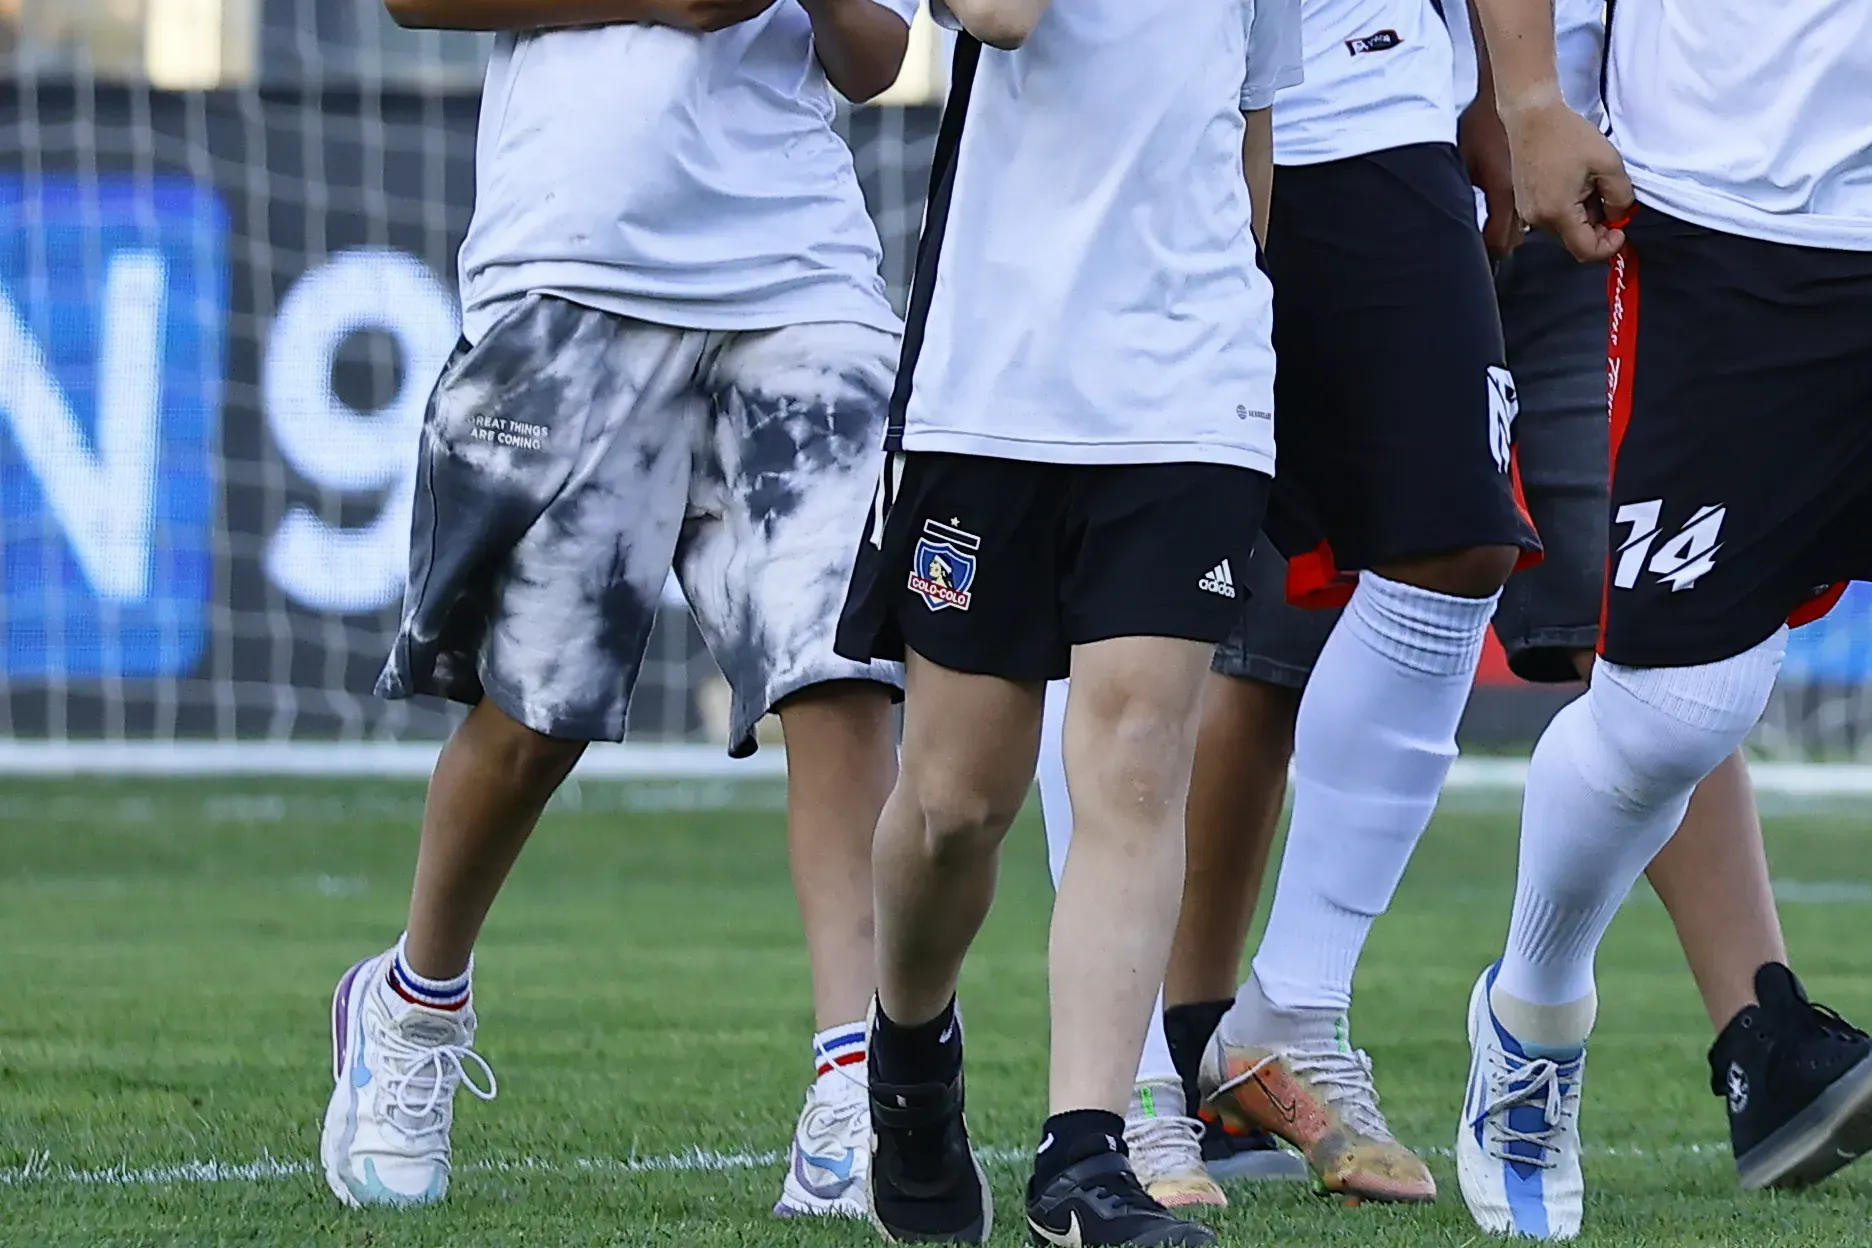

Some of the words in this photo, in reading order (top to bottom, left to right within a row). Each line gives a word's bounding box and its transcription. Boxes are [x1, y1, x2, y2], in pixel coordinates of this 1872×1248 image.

[470, 427, 495, 441] ARE
[497, 432, 541, 450] COMING
[509, 420, 549, 437] THINGS
[1614, 498, 1727, 593] 14
[912, 577, 967, 606] COLO-COLO
[1198, 578, 1236, 599] adidas
